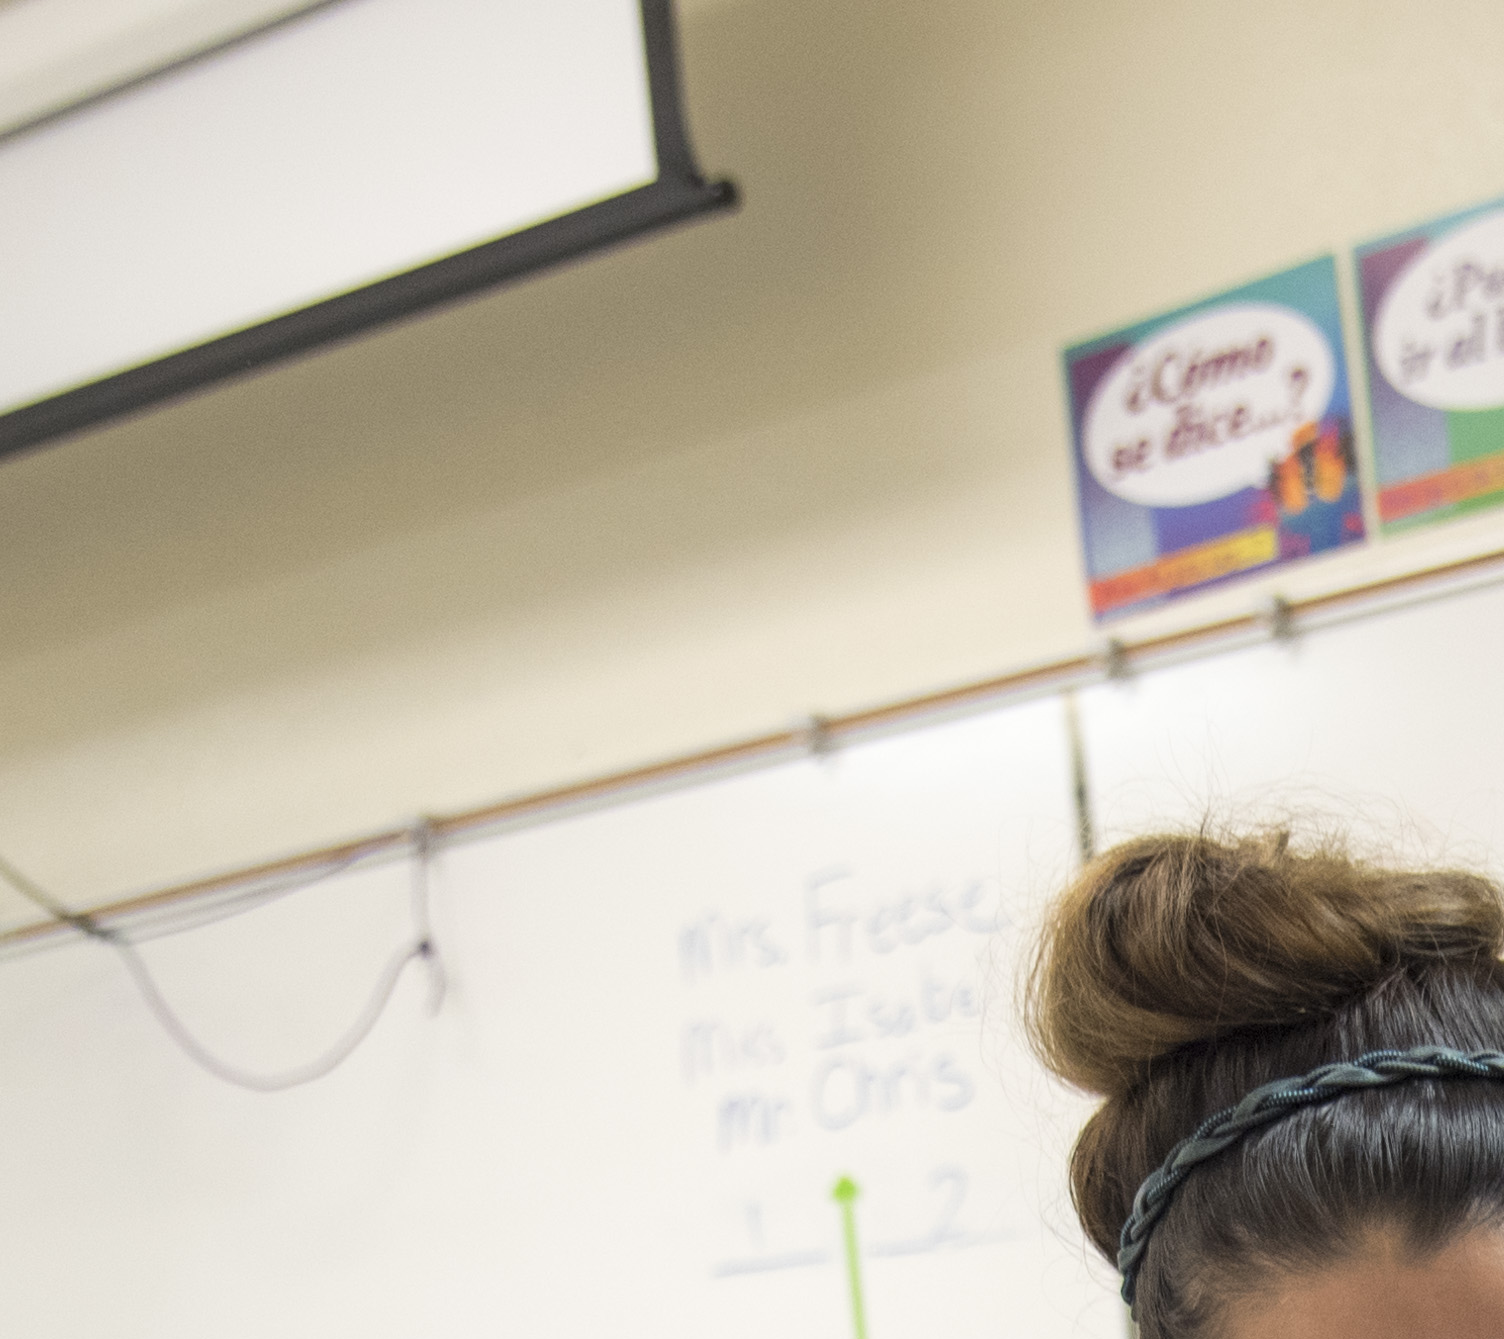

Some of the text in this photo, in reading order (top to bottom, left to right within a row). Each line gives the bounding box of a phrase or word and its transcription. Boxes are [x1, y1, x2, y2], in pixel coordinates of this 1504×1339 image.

[1400, 338, 1436, 387] ir
[1443, 314, 1492, 365] al
[1109, 440, 1152, 483] se
